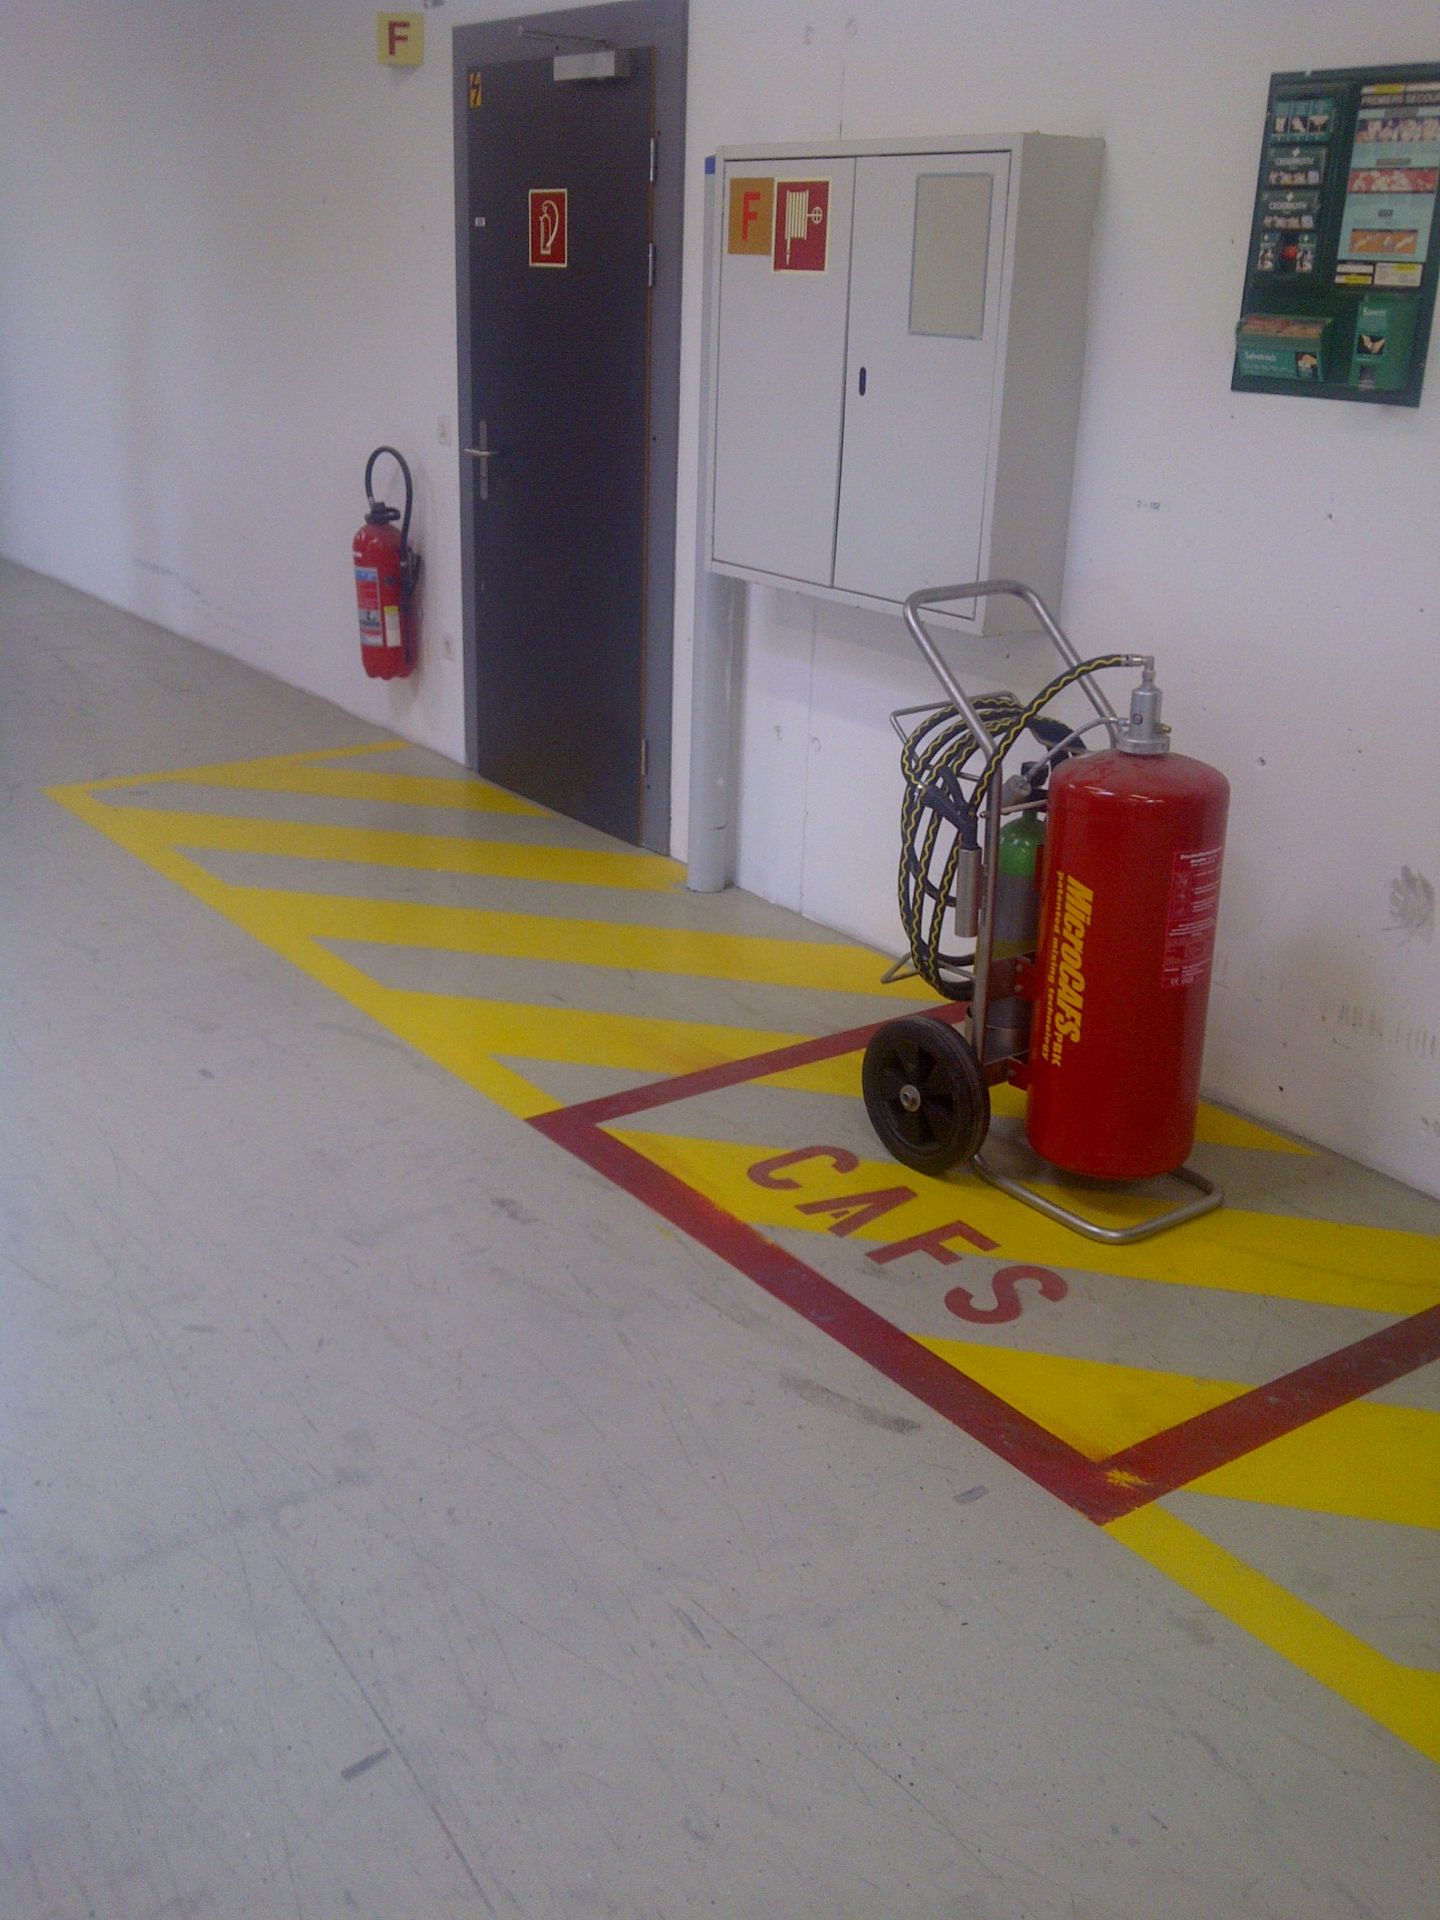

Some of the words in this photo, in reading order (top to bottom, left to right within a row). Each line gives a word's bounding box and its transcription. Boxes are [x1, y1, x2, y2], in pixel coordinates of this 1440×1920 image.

[388, 21, 410, 56] F
[741, 190, 761, 241] F
[1053, 871, 1065, 934] patented
[1047, 937, 1058, 983] mixing
[1054, 875, 1094, 1043] MicroCAFS
[1041, 988, 1055, 1061] technology
[747, 1145, 1068, 1325] CAFS
